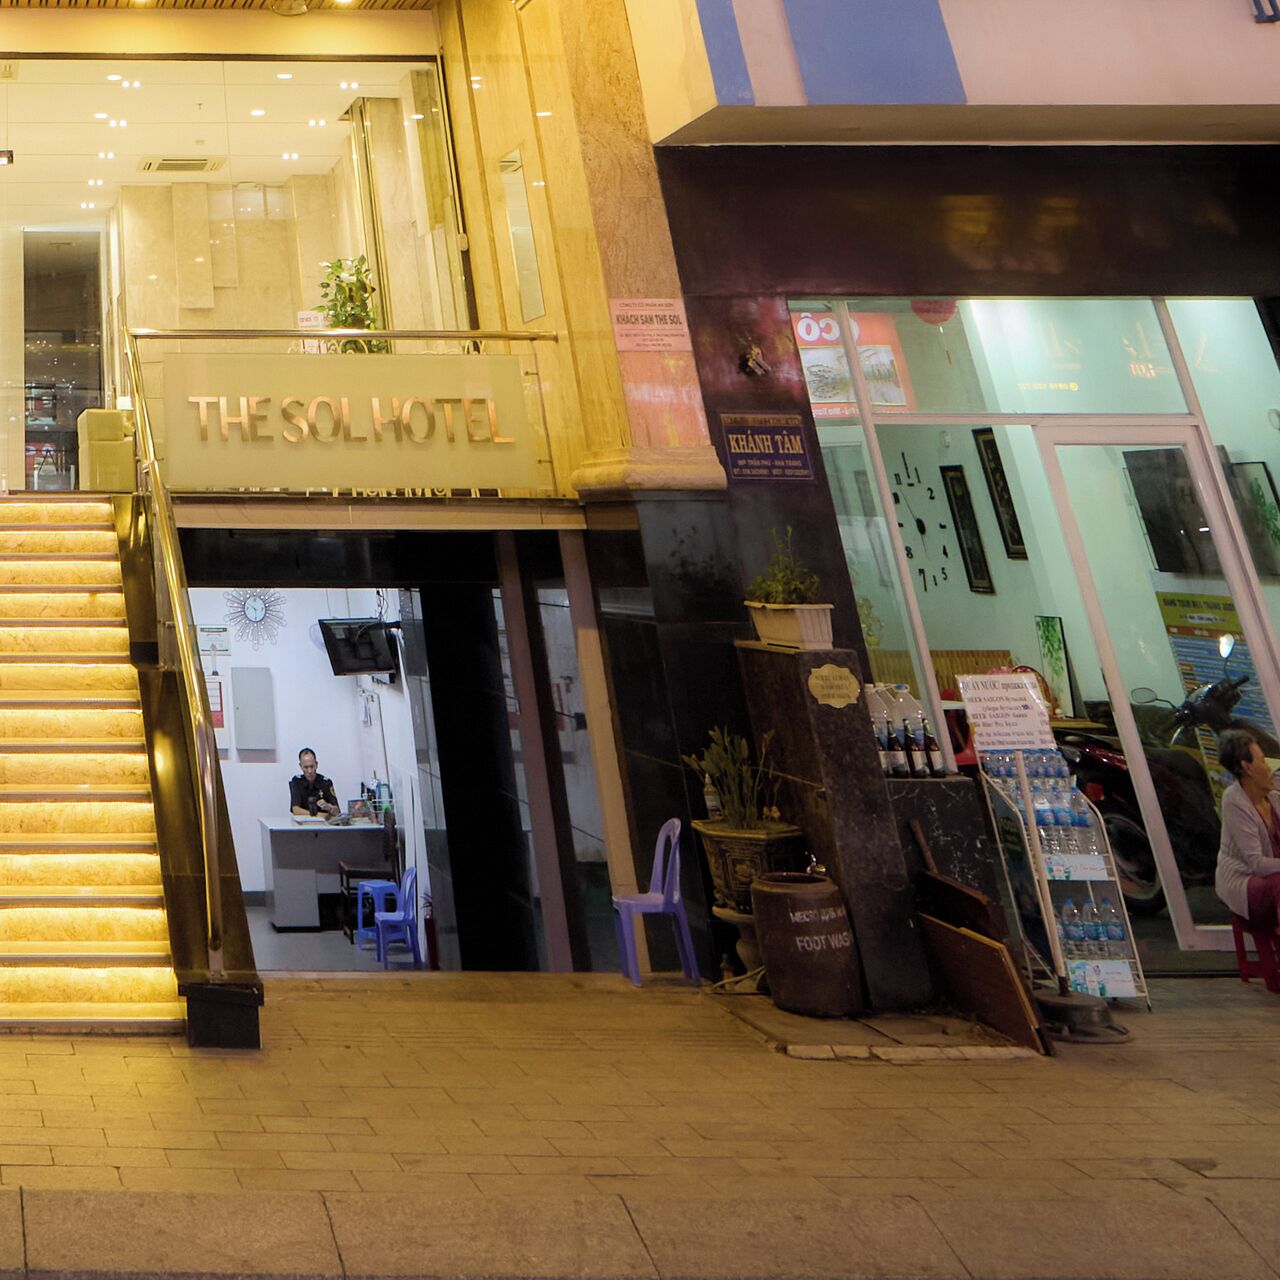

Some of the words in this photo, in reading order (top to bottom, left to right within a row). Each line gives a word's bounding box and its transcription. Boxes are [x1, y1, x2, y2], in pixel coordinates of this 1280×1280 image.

[654, 314, 668, 325] THE
[669, 314, 683, 325] SOL
[188, 396, 274, 442] THE
[281, 395, 367, 443] SOL
[372, 396, 515, 443] HOTEL
[728, 429, 774, 453] KHÁNH
[774, 430, 804, 454] TÂM
[795, 936, 826, 951] FOOT
